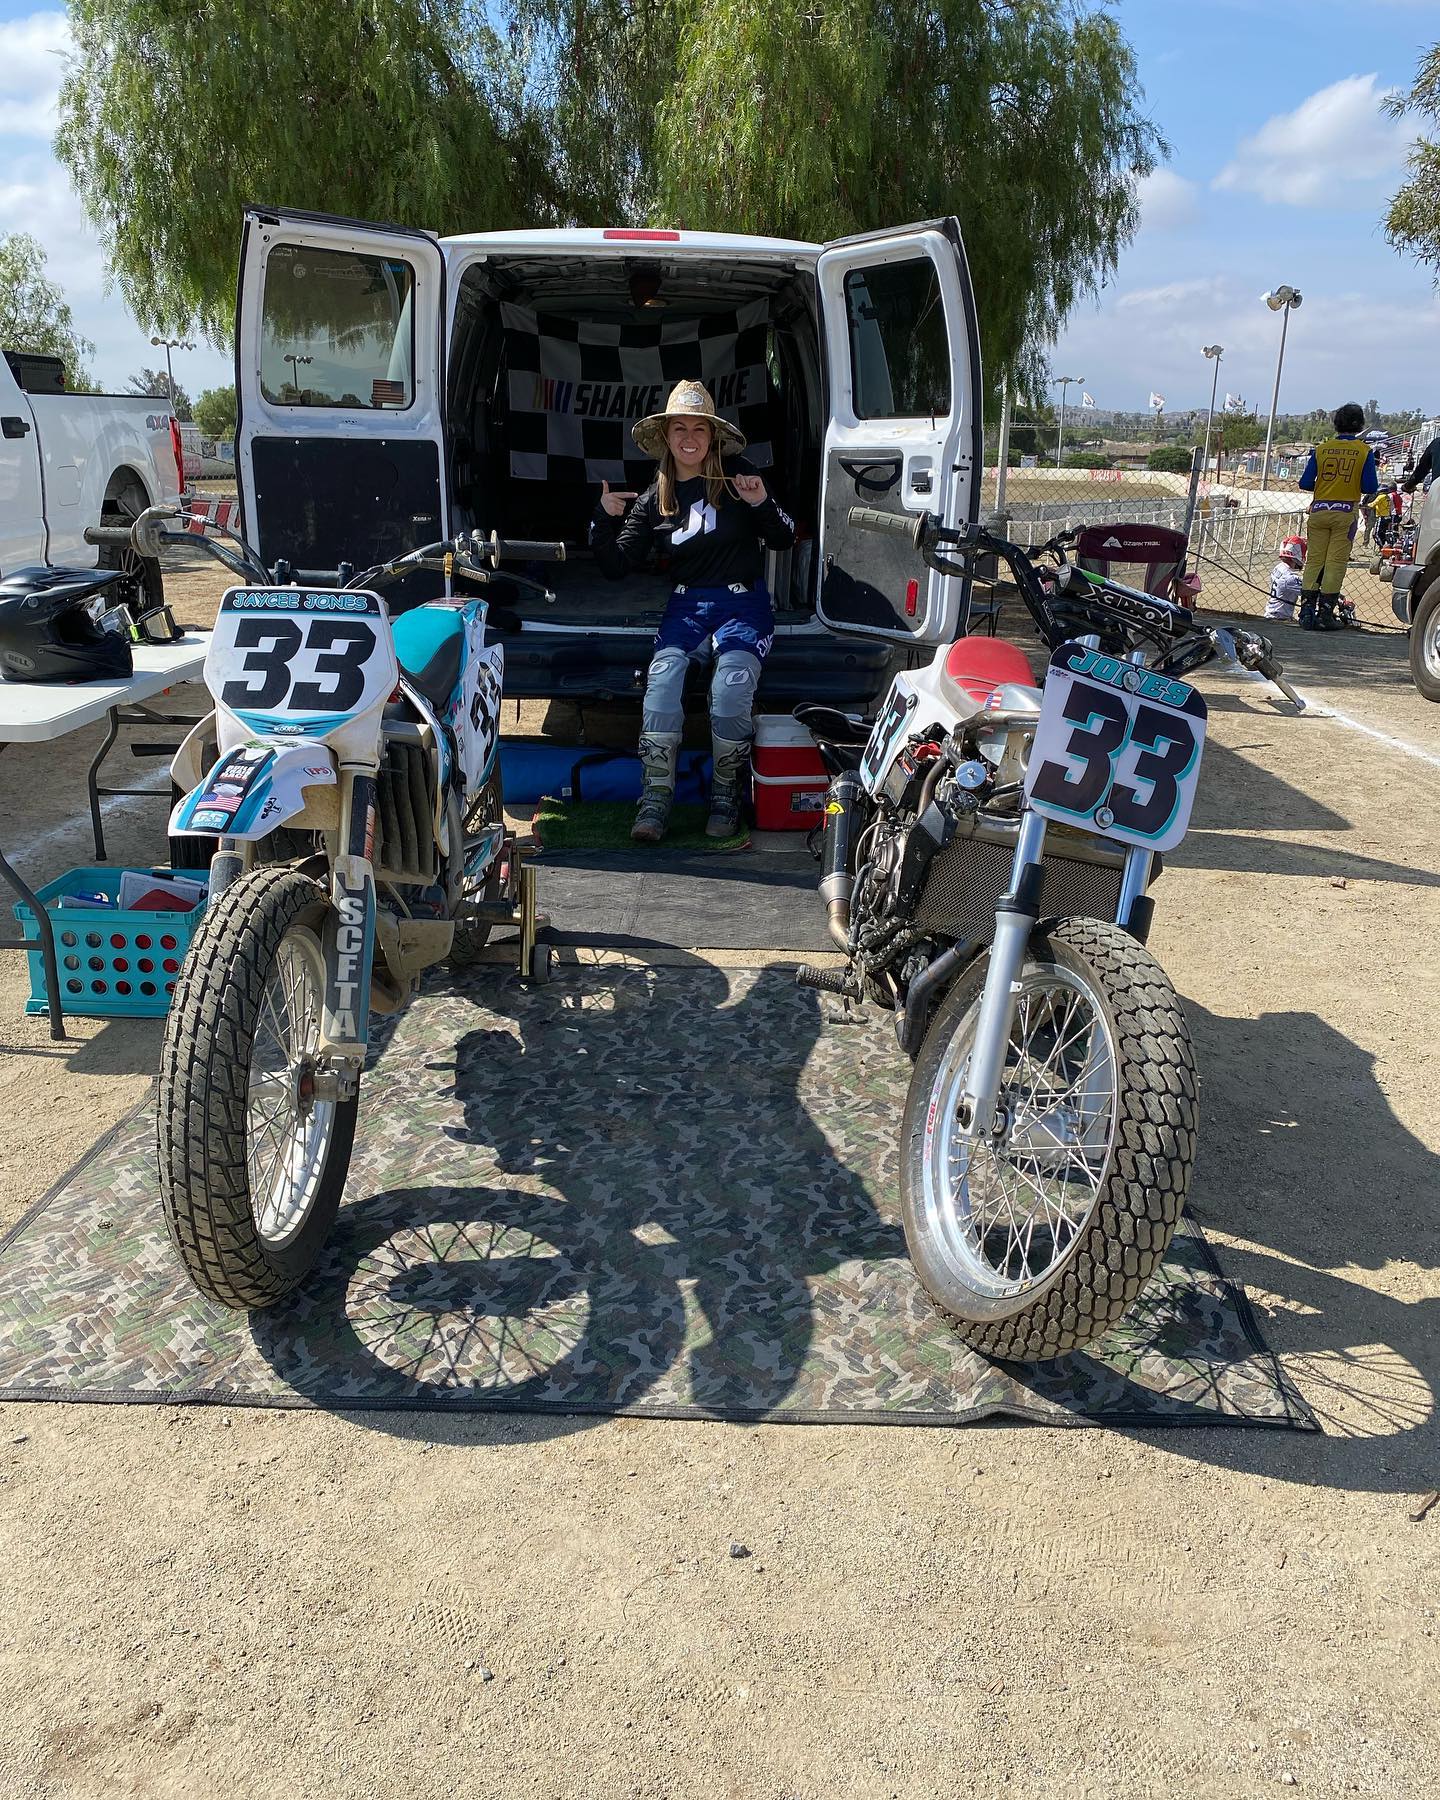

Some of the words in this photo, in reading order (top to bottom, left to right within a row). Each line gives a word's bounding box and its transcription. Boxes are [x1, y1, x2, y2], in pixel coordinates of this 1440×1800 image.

[573, 383, 663, 418] SHAKE
[1321, 457, 1356, 483] 84
[1322, 448, 1360, 456] FOSTER
[233, 592, 300, 608] JAYCEE
[304, 594, 368, 611] JONES
[1080, 582, 1173, 631] VORTEX
[221, 618, 377, 712] 33
[1067, 647, 1194, 708] JONES
[1030, 680, 1199, 840] 33
[329, 896, 363, 1038] SCFTA
